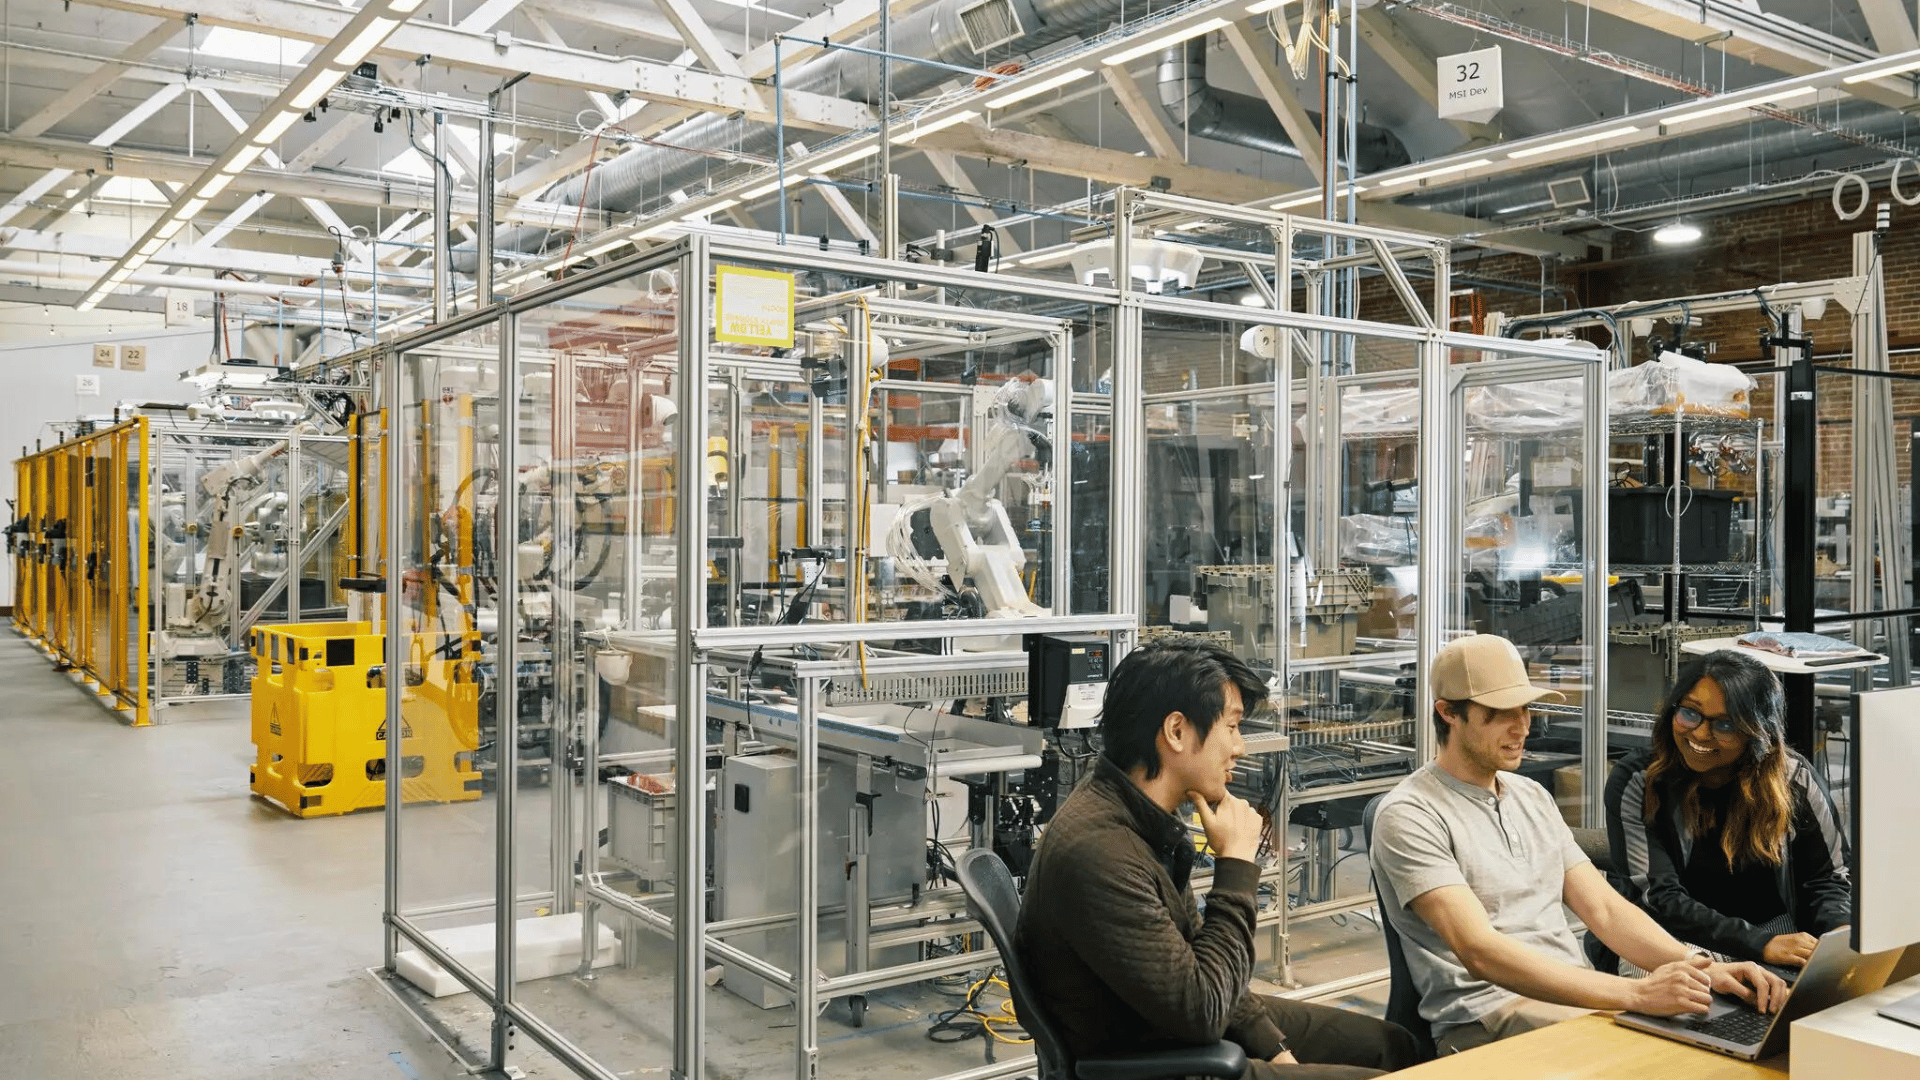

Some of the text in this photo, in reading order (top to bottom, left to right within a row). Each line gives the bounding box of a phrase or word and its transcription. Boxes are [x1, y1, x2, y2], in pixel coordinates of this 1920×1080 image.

[1456, 62, 1480, 82] 32
[1449, 87, 1488, 100] MSI Dev
[176, 302, 188, 312] 18
[730, 322, 771, 337] YELLOW
[100, 349, 110, 357] 24
[128, 350, 140, 359] 22
[82, 379, 94, 387] 26
